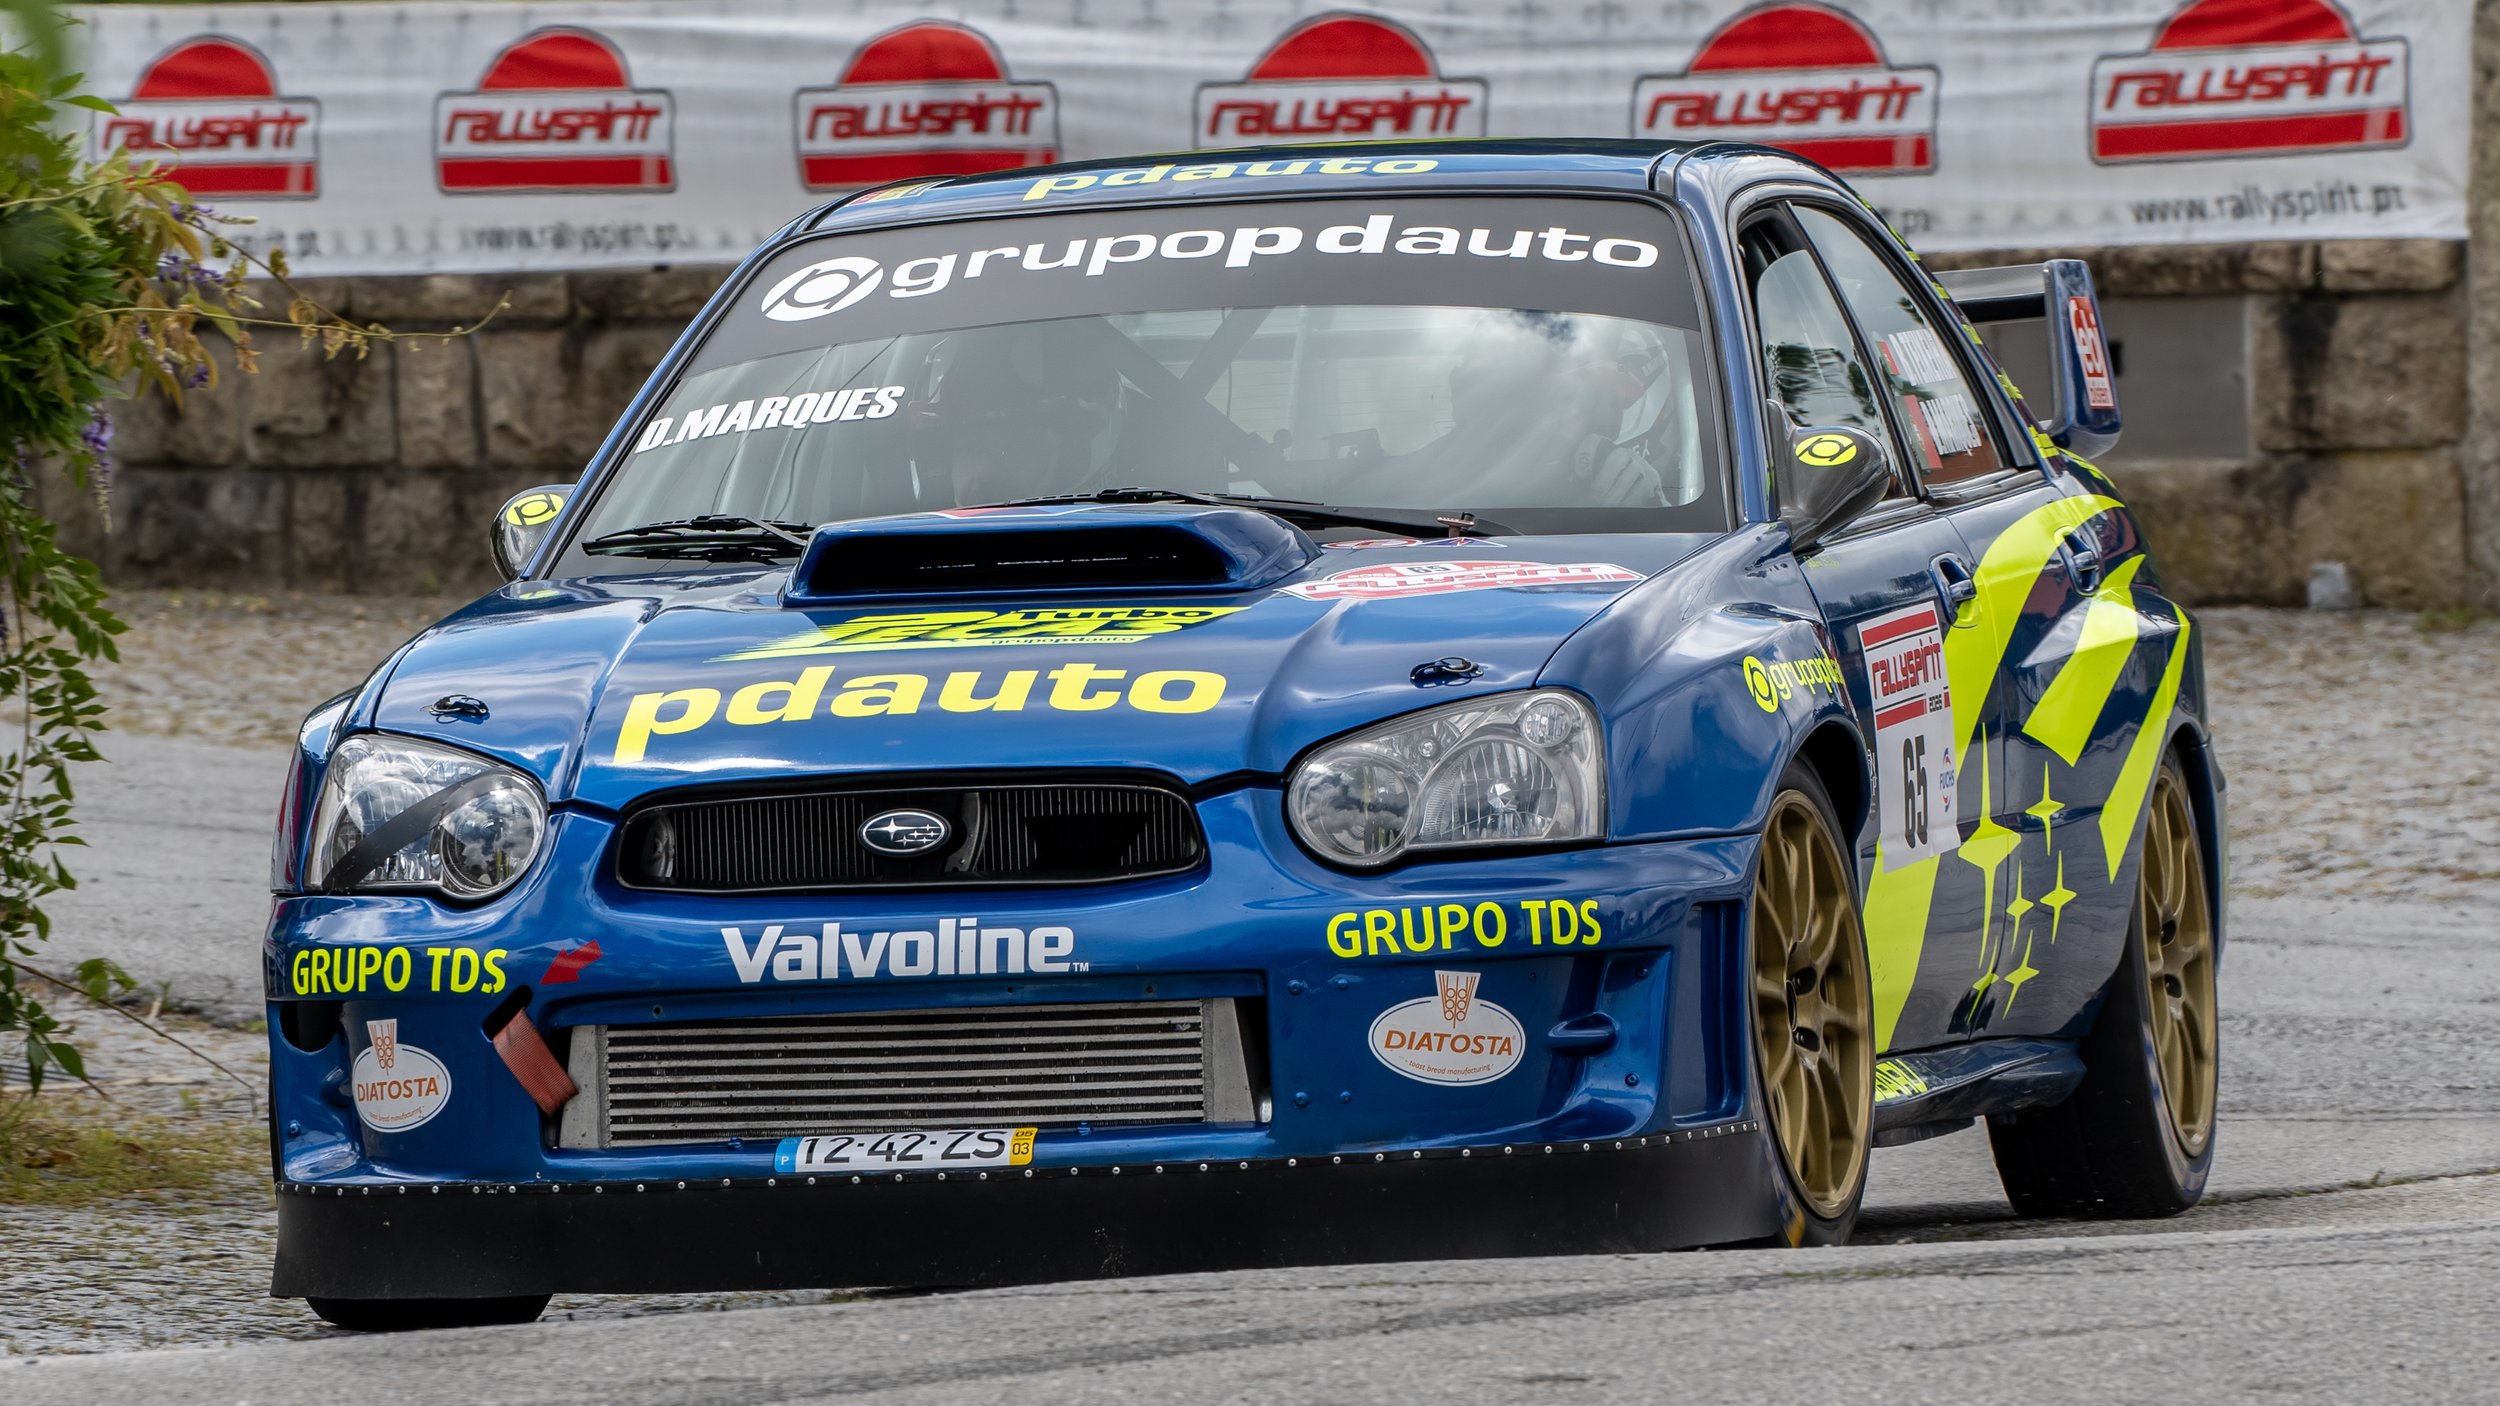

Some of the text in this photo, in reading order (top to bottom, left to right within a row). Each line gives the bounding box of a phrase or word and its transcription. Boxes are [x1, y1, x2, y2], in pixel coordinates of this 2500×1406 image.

[1022, 156, 1439, 200] pdauto
[889, 214, 1660, 300] grupopdauto
[635, 384, 905, 454] D.MARQUES
[1020, 609, 1214, 620] Turbo
[1872, 636, 1942, 700] rallyspirit
[613, 662, 1227, 766] pdauto
[1903, 734, 1929, 849] 65
[1939, 768, 1955, 790] FUCHS
[720, 917, 1075, 983] Valvoline
[1326, 899, 1602, 958] GRUPO TDS
[292, 946, 508, 995] GRUPO TDS
[1384, 1029, 1512, 1056] DIATOSTA
[357, 1077, 439, 1102] DIATOSTA
[1408, 1059, 1491, 1076] toast bread manufacturing
[781, 1156, 789, 1165] P
[1012, 1142, 1030, 1155] 03
